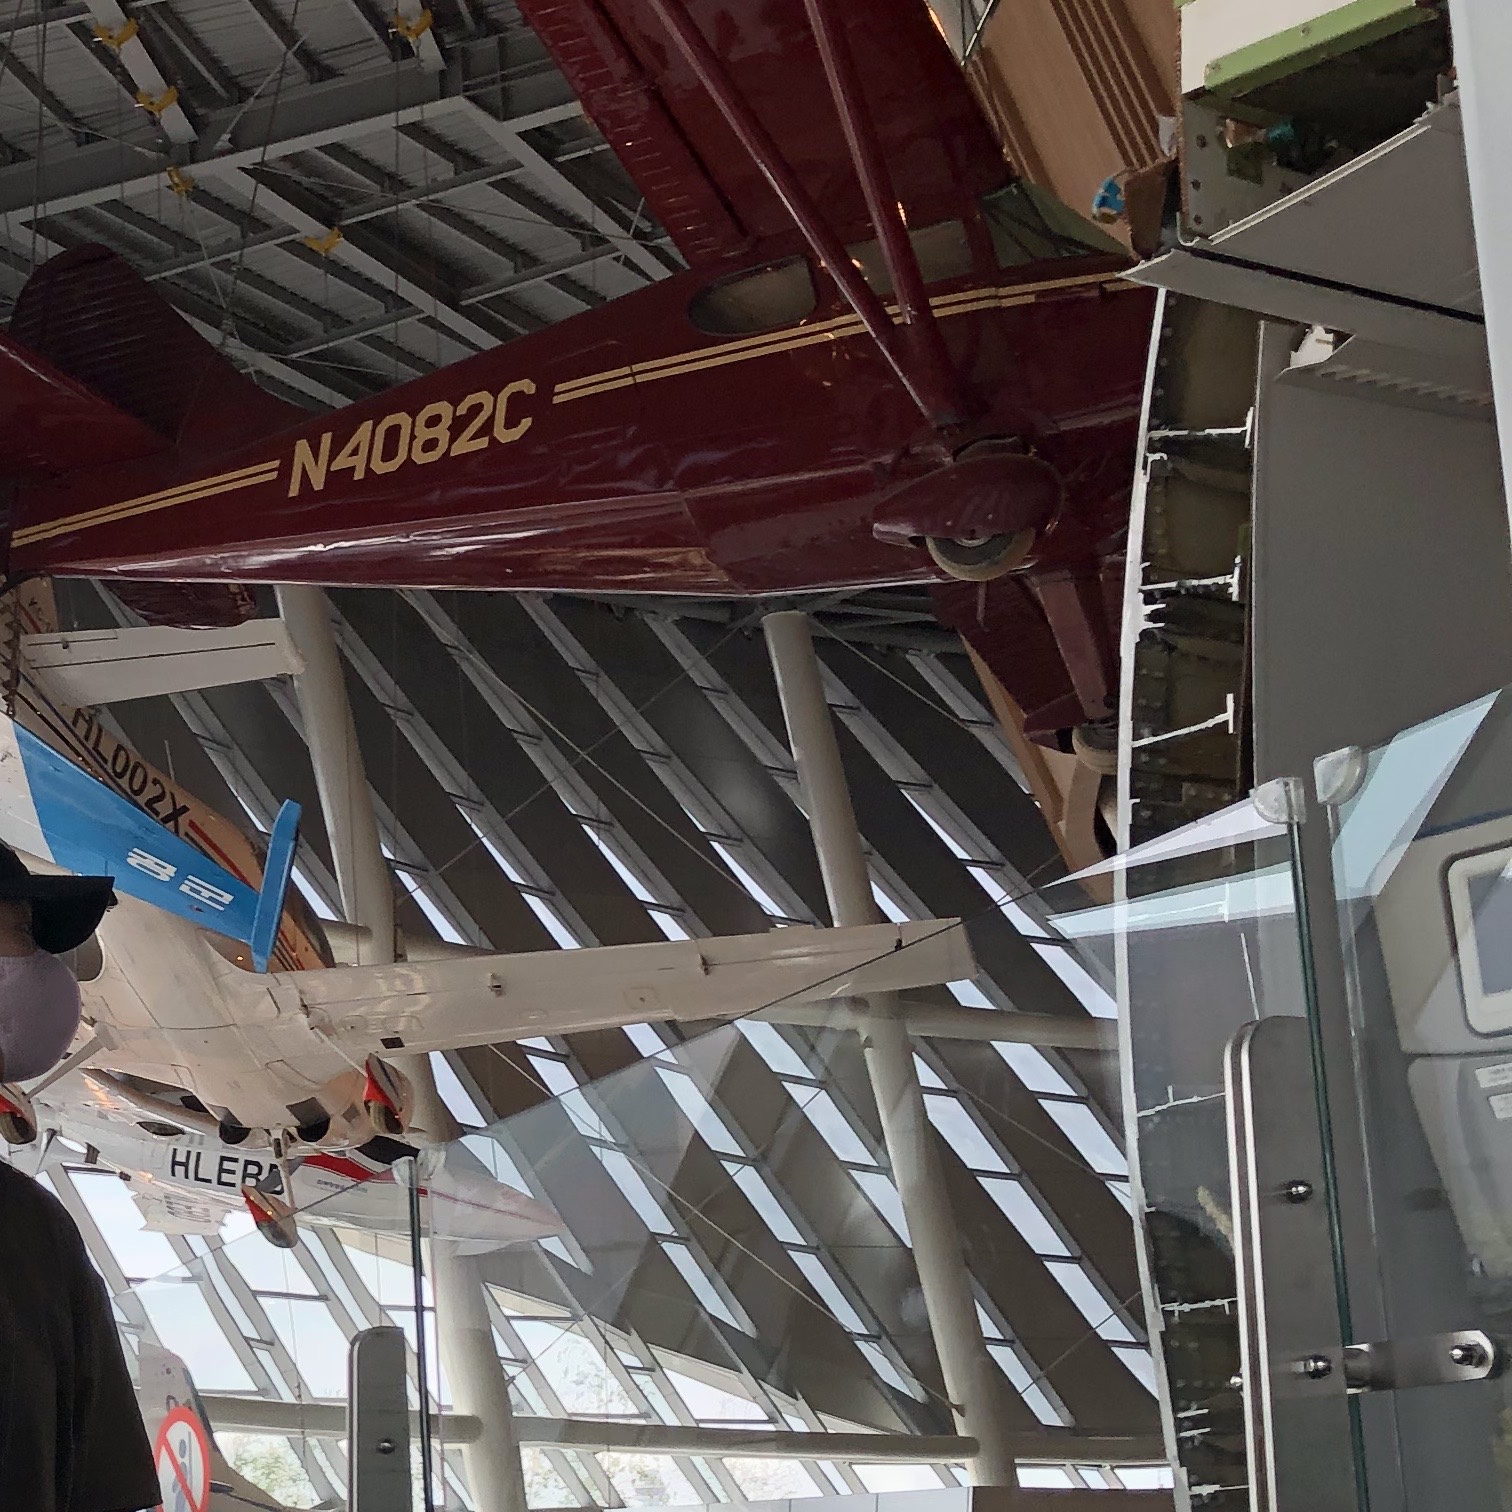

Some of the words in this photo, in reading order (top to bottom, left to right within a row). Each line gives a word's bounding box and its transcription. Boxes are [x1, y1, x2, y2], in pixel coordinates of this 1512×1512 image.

[288, 378, 536, 496] N4082C
[72, 707, 191, 834] HL002X
[126, 847, 235, 911] 공군
